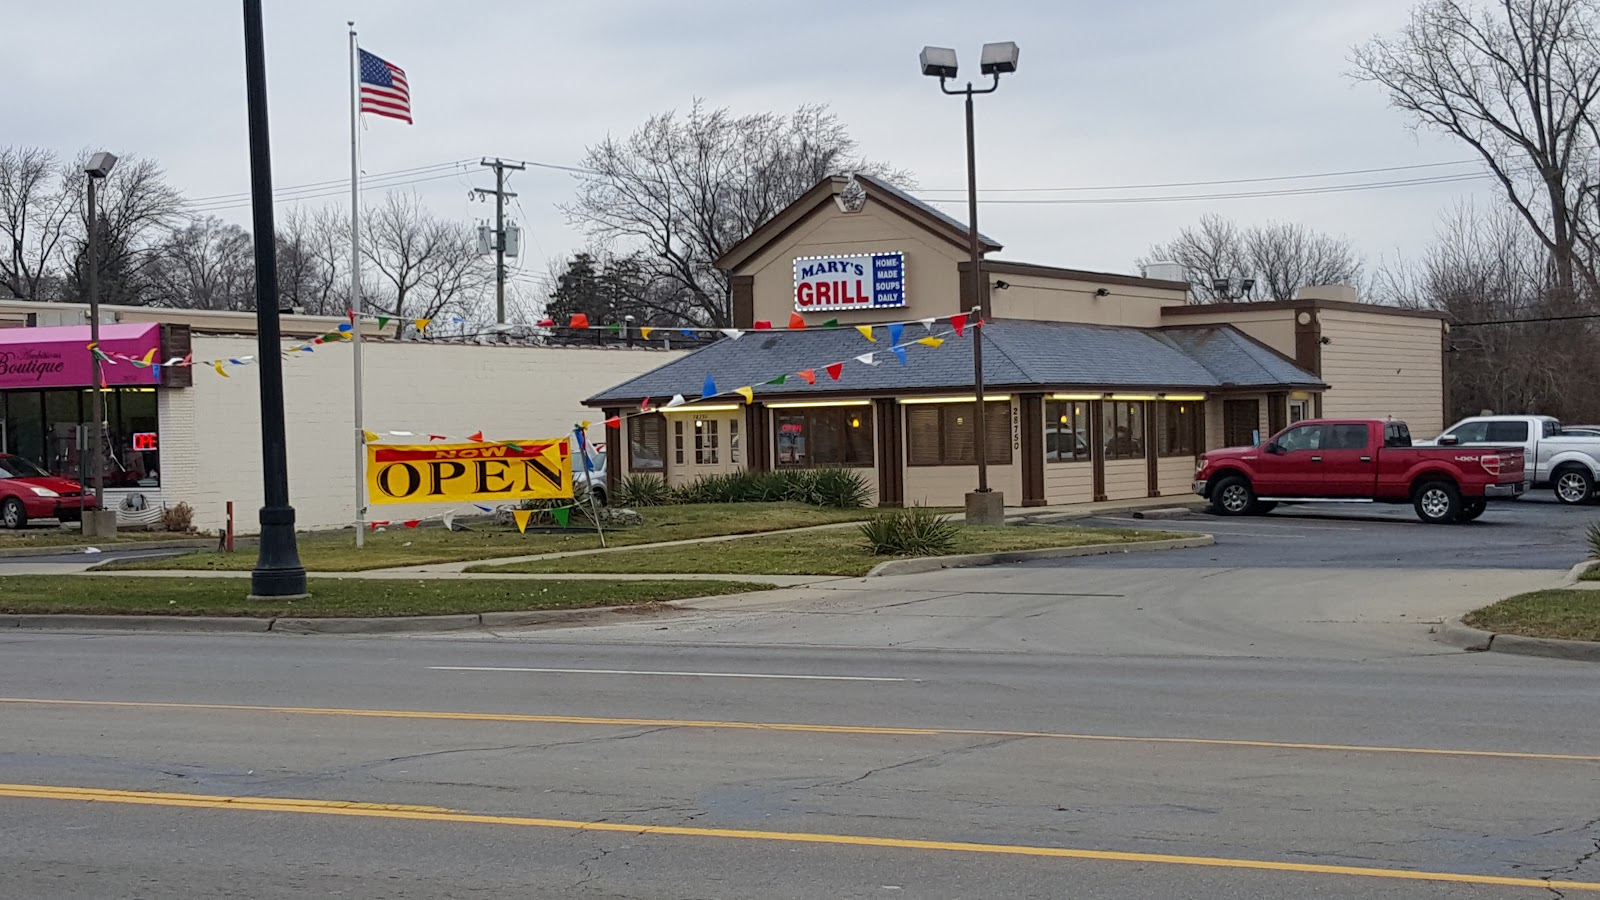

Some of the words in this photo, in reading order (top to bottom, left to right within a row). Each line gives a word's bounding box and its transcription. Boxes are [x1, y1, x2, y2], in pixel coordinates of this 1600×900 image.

[801, 261, 864, 280] MARY'S
[876, 259, 899, 268] HOME-
[878, 270, 898, 279] MADE
[876, 281, 900, 291] SOUPS
[797, 280, 869, 307] GRILL
[878, 293, 898, 302] DAILY
[0, 350, 64, 381] Boutique
[136, 434, 157, 449] OPE
[435, 446, 508, 459] NOW
[377, 459, 567, 498] OPEN
